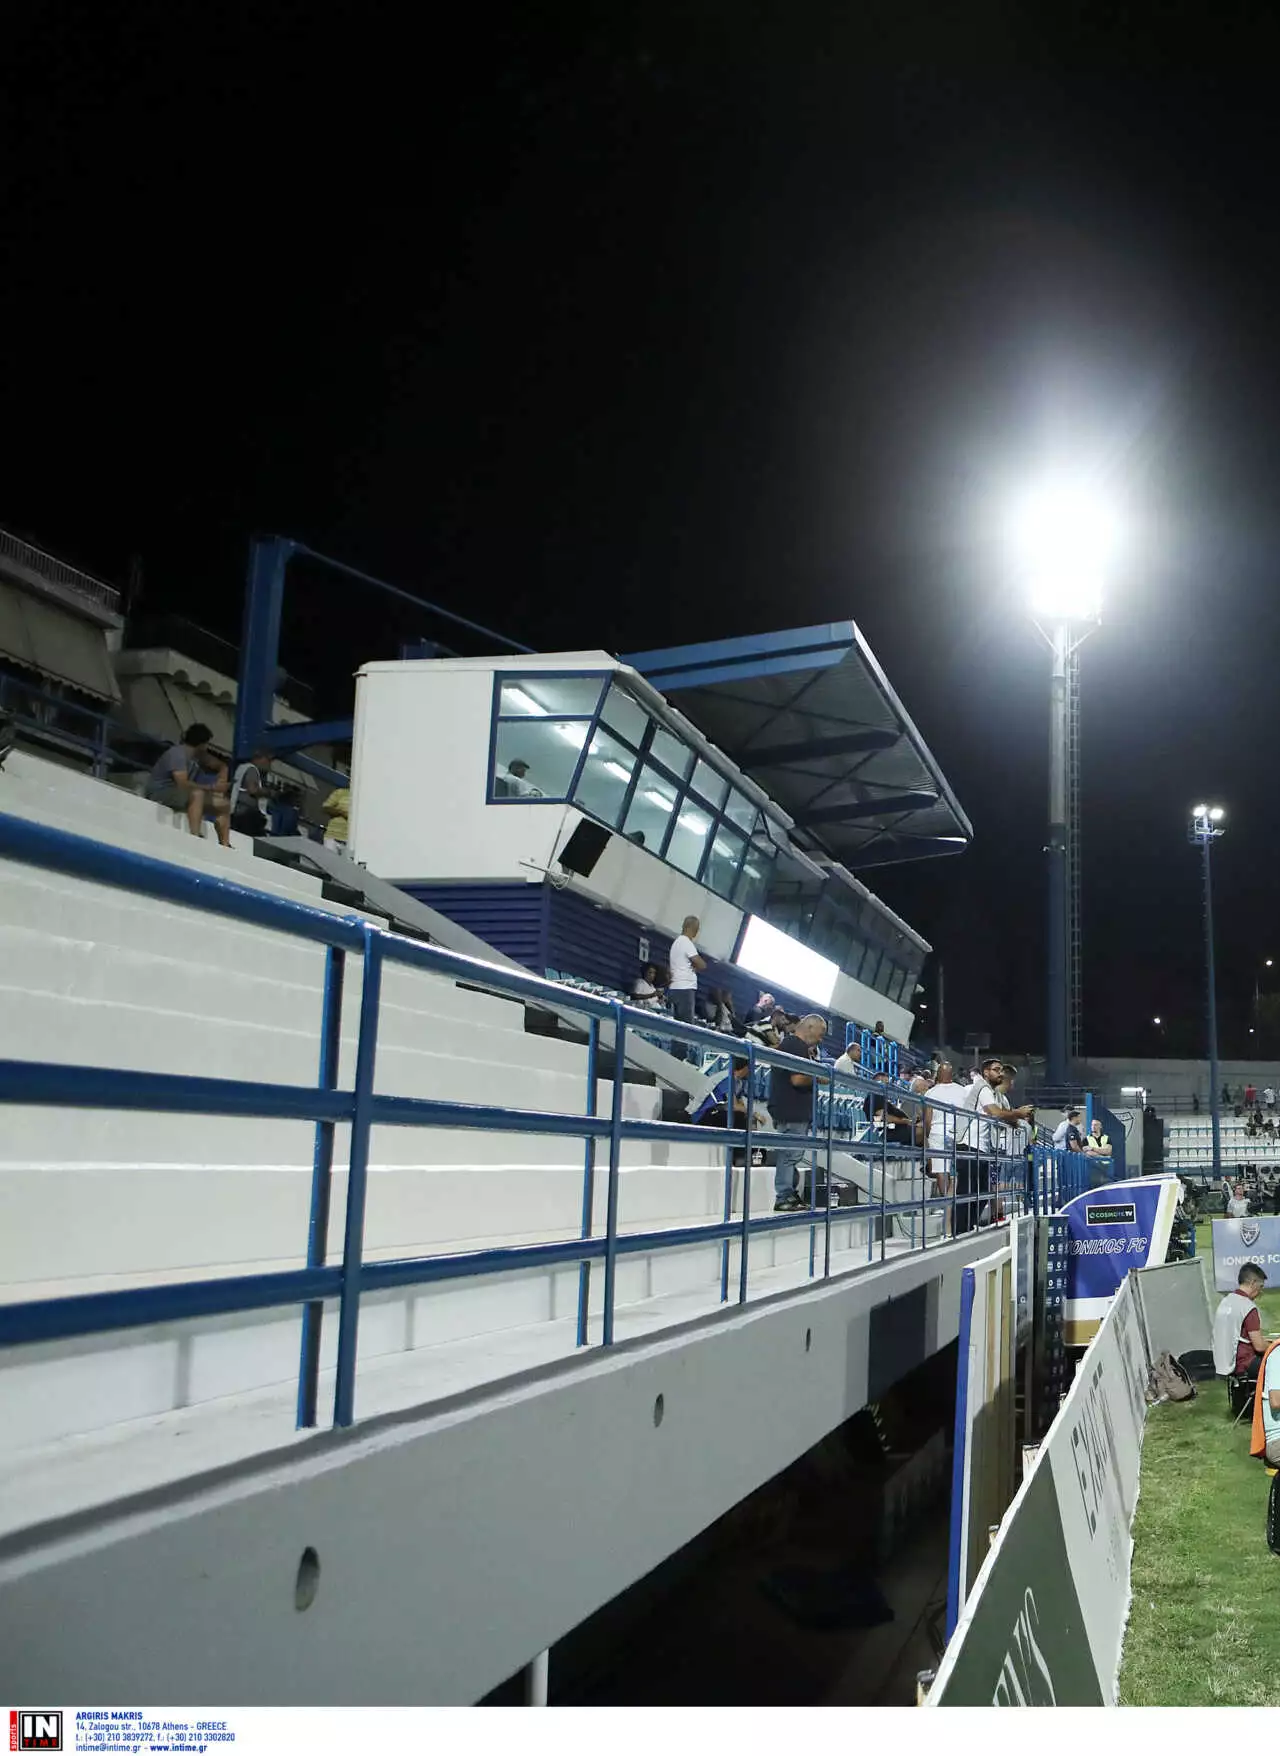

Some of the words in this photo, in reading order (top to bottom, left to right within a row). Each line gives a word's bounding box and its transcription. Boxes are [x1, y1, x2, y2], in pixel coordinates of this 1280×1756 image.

[1126, 1236, 1148, 1253] FC
[1222, 1255, 1265, 1266] IONIKOS
[1267, 1253, 1280, 1264] FC
